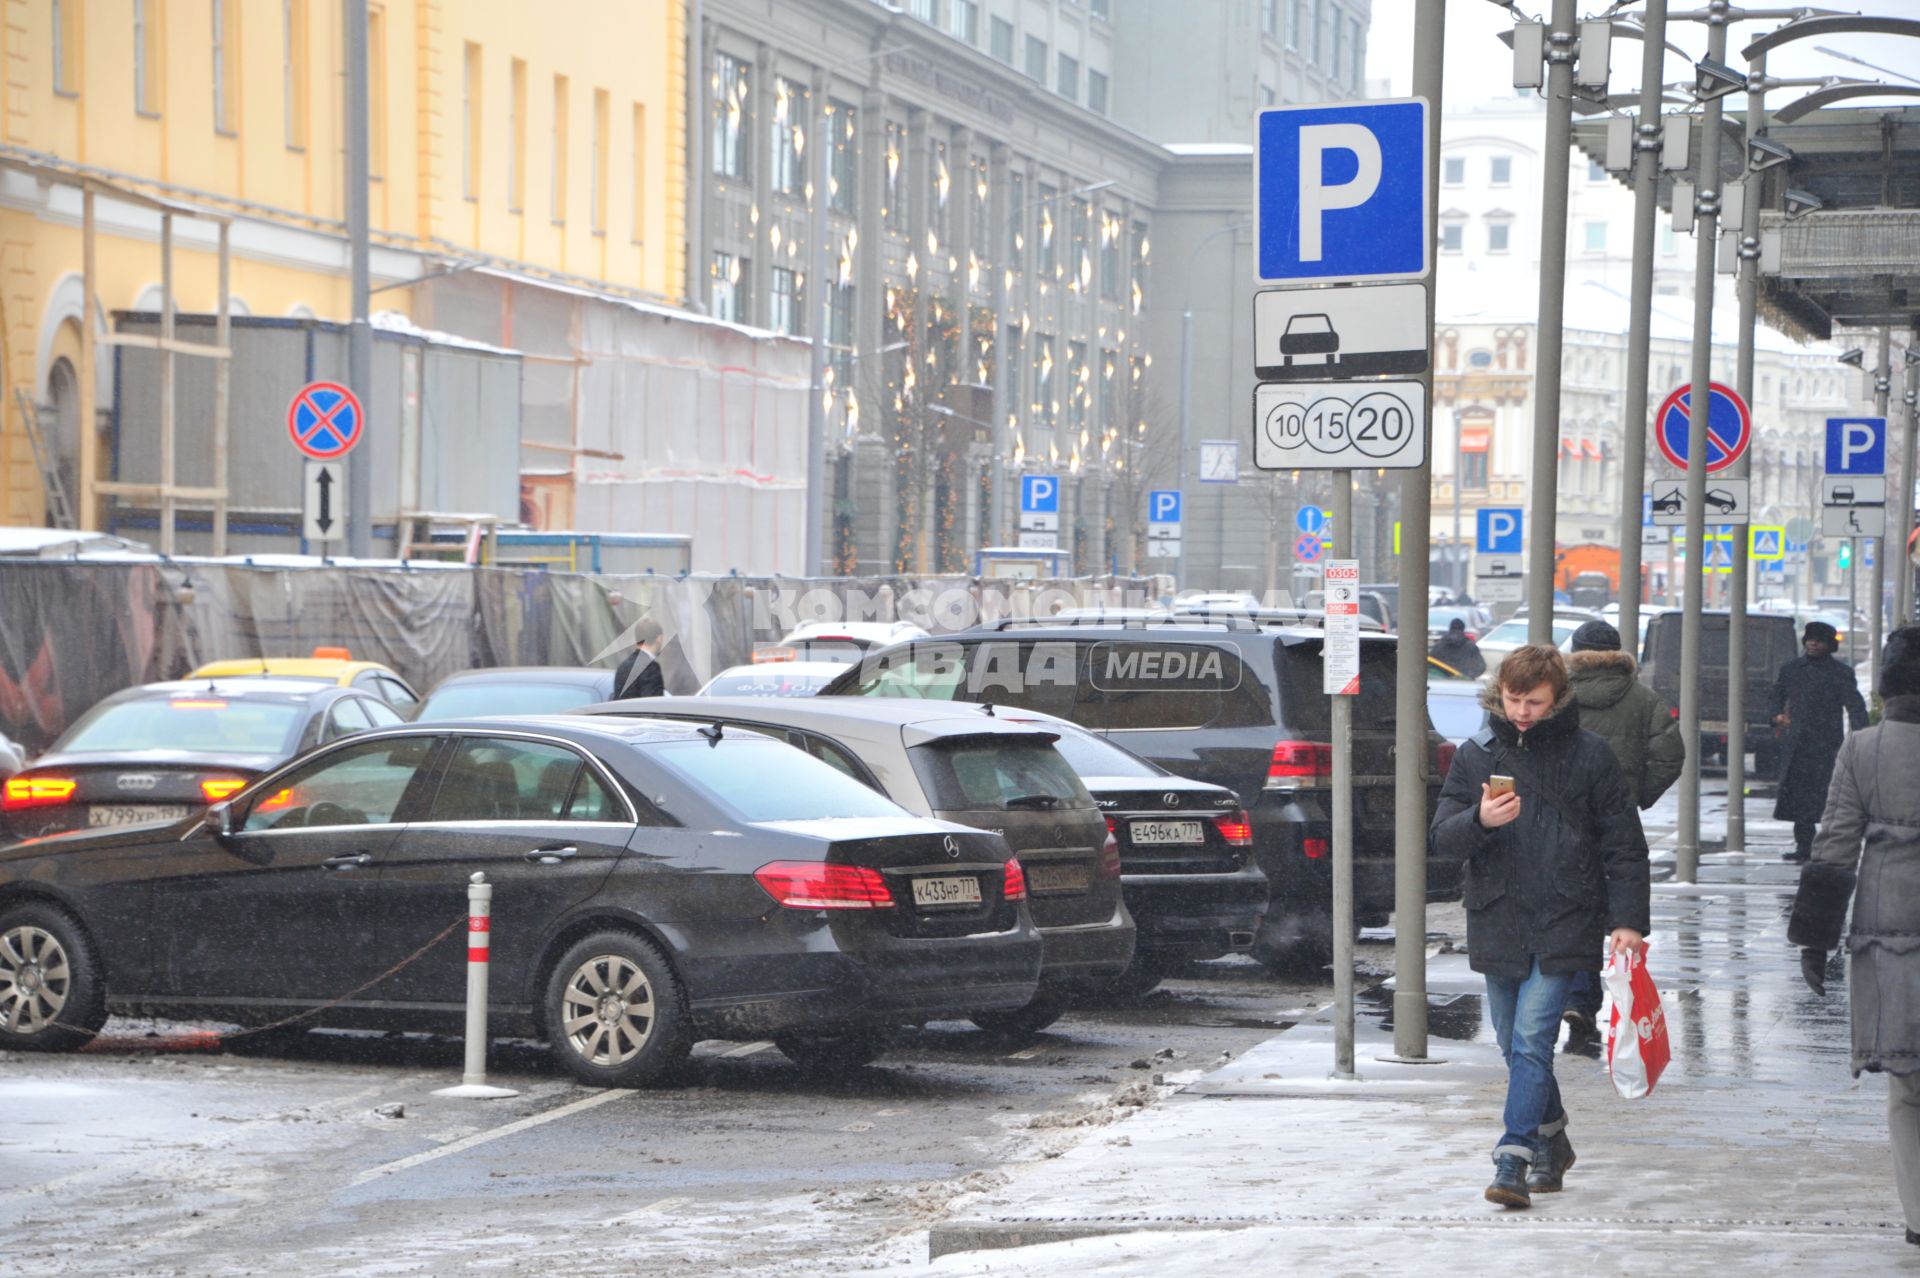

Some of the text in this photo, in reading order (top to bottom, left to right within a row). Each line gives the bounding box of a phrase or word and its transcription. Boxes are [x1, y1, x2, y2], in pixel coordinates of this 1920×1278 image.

[1299, 123, 1383, 262] P
[1275, 406, 1403, 441] 10 15 20
[1841, 423, 1876, 470] P
[1031, 479, 1053, 509] P
[1156, 494, 1177, 520] P
[1488, 512, 1516, 550] P
[1328, 569, 1357, 578] 0305
[1182, 823, 1199, 836] 777
[960, 878, 975, 894] 777
